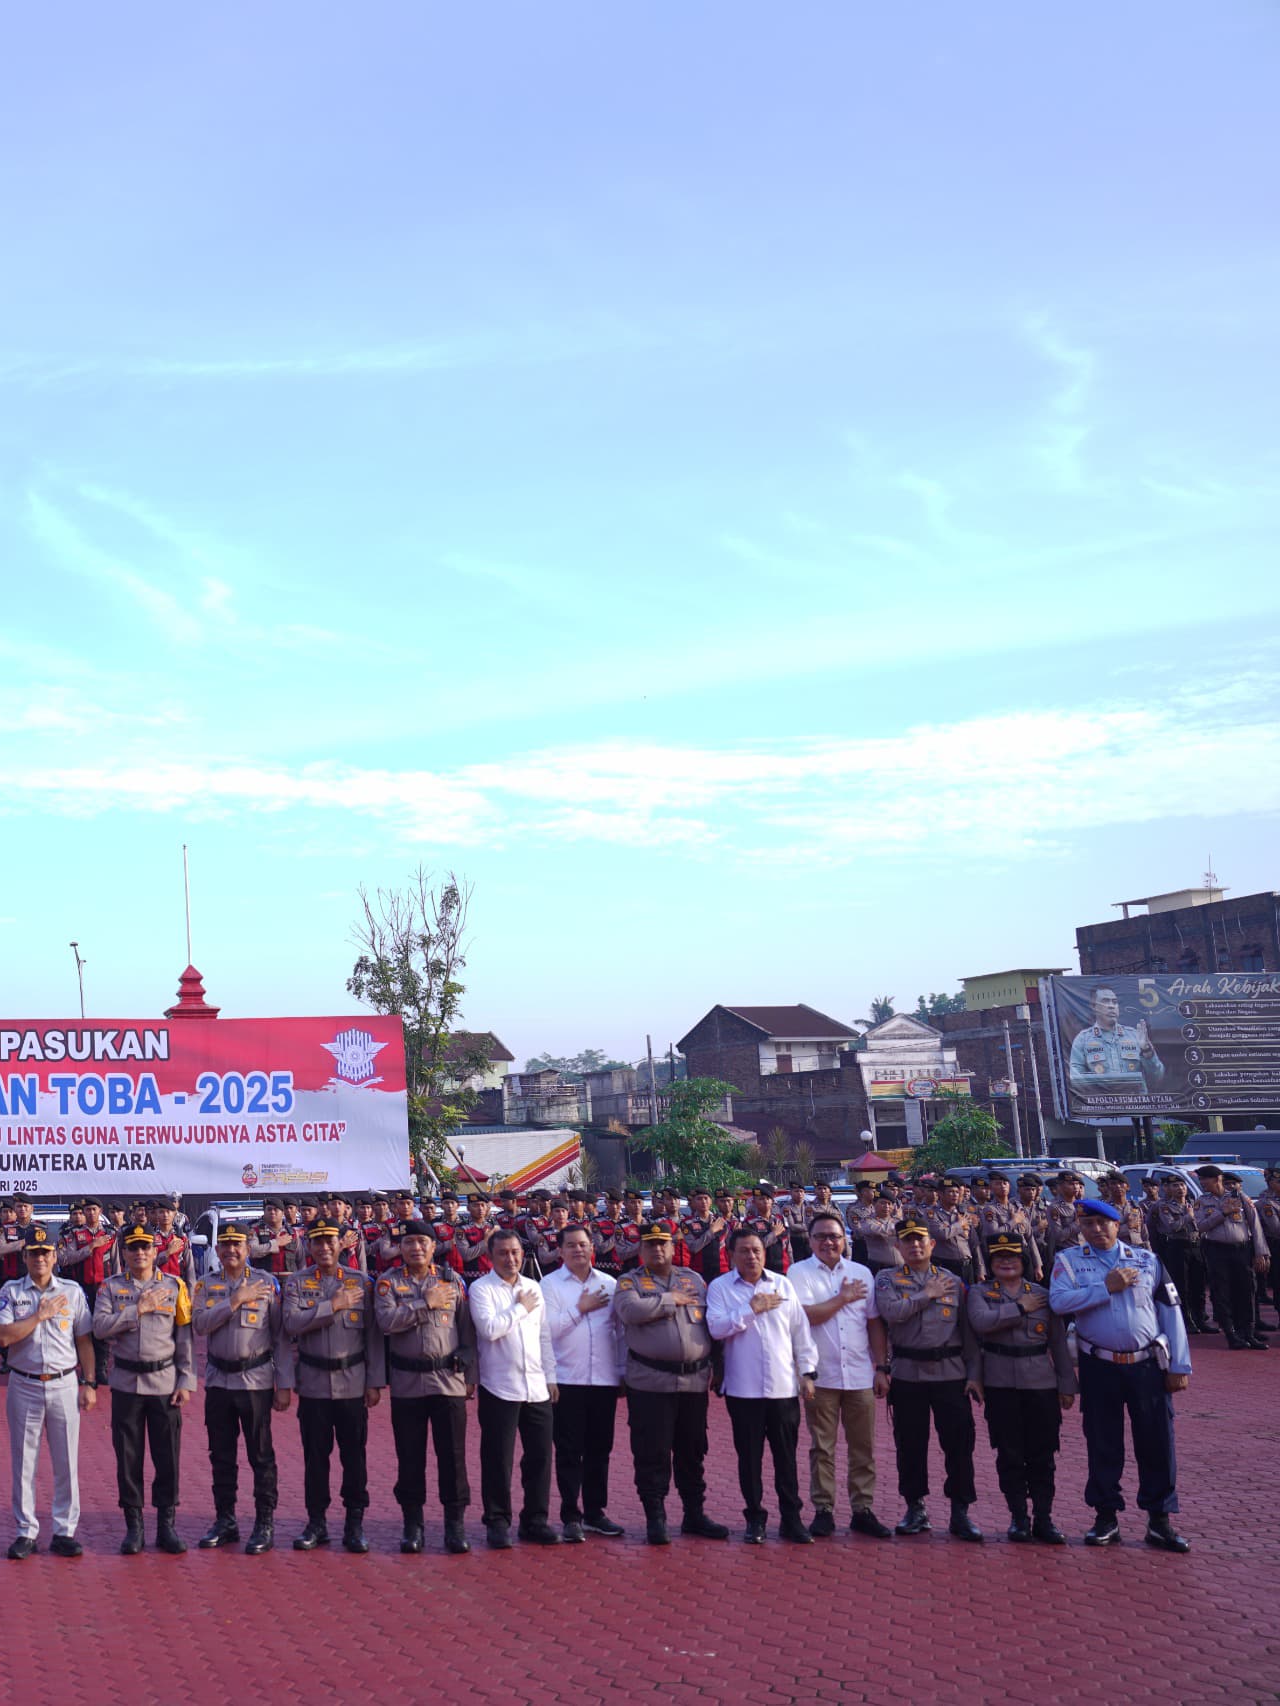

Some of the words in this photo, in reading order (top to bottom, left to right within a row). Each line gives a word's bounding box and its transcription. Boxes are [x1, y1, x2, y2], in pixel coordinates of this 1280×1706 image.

[1138, 979, 1160, 1007] 5
[1167, 978, 1214, 996] Arah
[1183, 1005, 1192, 1015] 1
[1186, 1028, 1196, 1038] 2
[0, 1030, 168, 1060] PASUKAN
[1191, 1051, 1199, 1061] 3
[1194, 1073, 1202, 1084] 4
[50, 1077, 163, 1116] TOBA
[175, 1095, 186, 1105] -
[199, 1075, 293, 1114] 2025
[7, 1126, 67, 1145] LINTAS
[72, 1126, 119, 1145] GUNA
[124, 1125, 250, 1145] TERWUJUDNYA
[255, 1124, 297, 1143] ASTA
[303, 1123, 346, 1142] CITA”
[93, 1153, 155, 1171] UTARA
[13, 1181, 38, 1191] 2025
